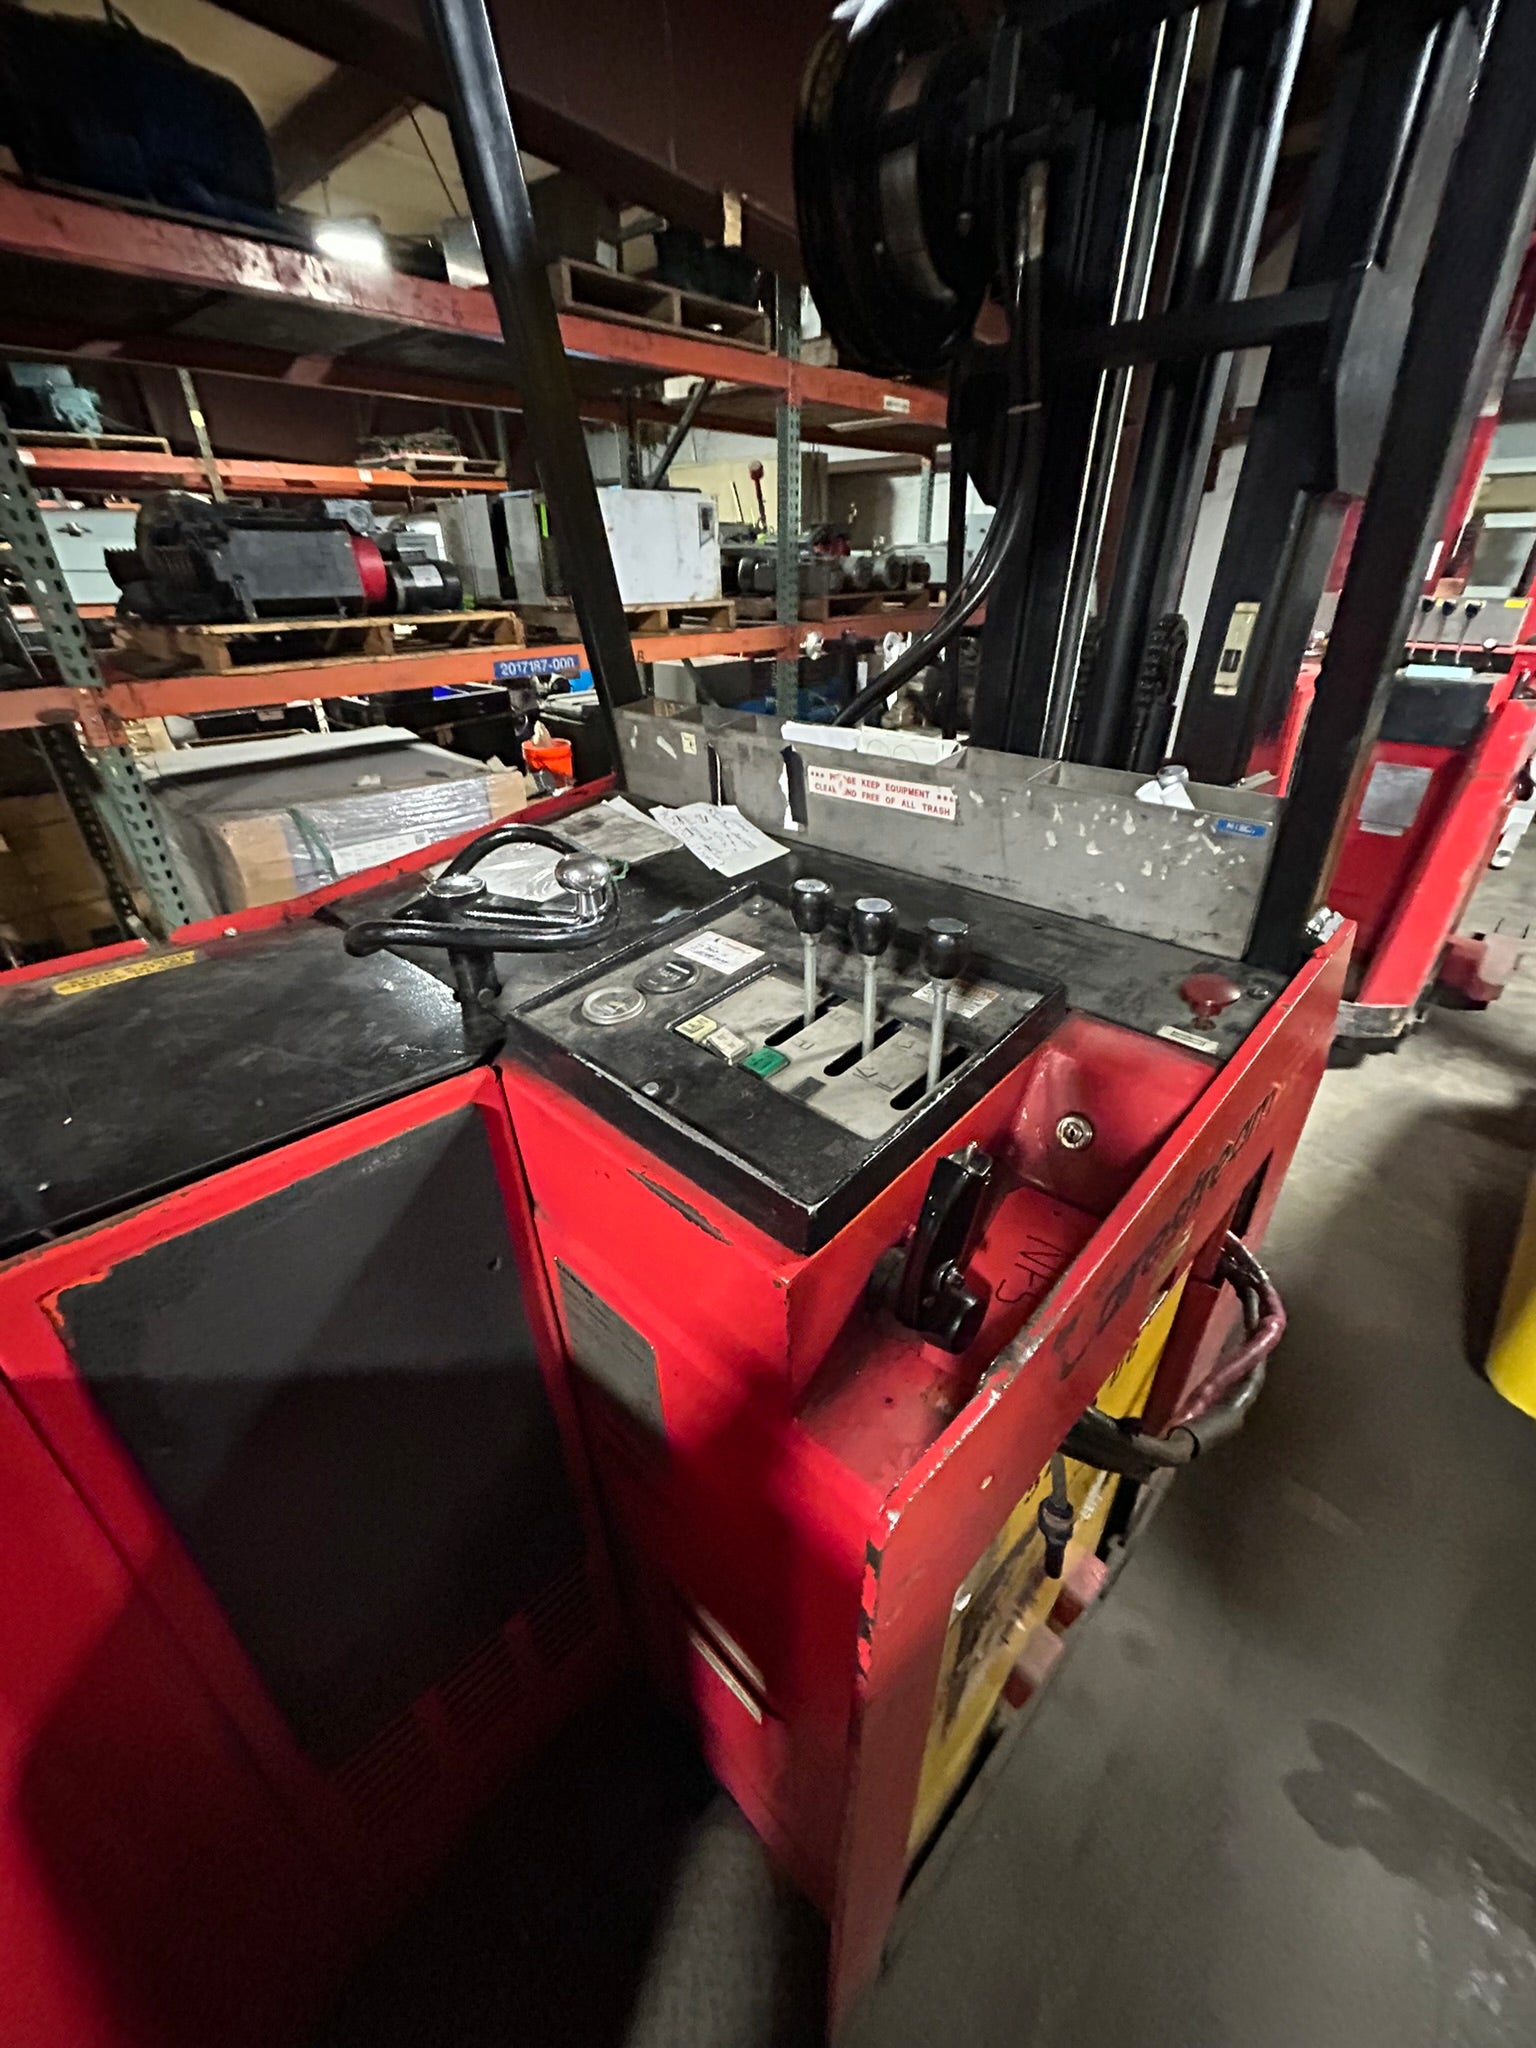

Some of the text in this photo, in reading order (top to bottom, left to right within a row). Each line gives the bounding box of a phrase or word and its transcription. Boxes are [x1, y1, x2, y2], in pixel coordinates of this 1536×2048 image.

[499, 656, 575, 676] 2017187-000
[861, 779, 881, 789] KEEP
[885, 783, 930, 799] EQUIPMENT
[861, 792, 880, 802] FREE
[885, 796, 896, 804] OF
[901, 799, 916, 809] ALL
[922, 803, 951, 816] TRASH
